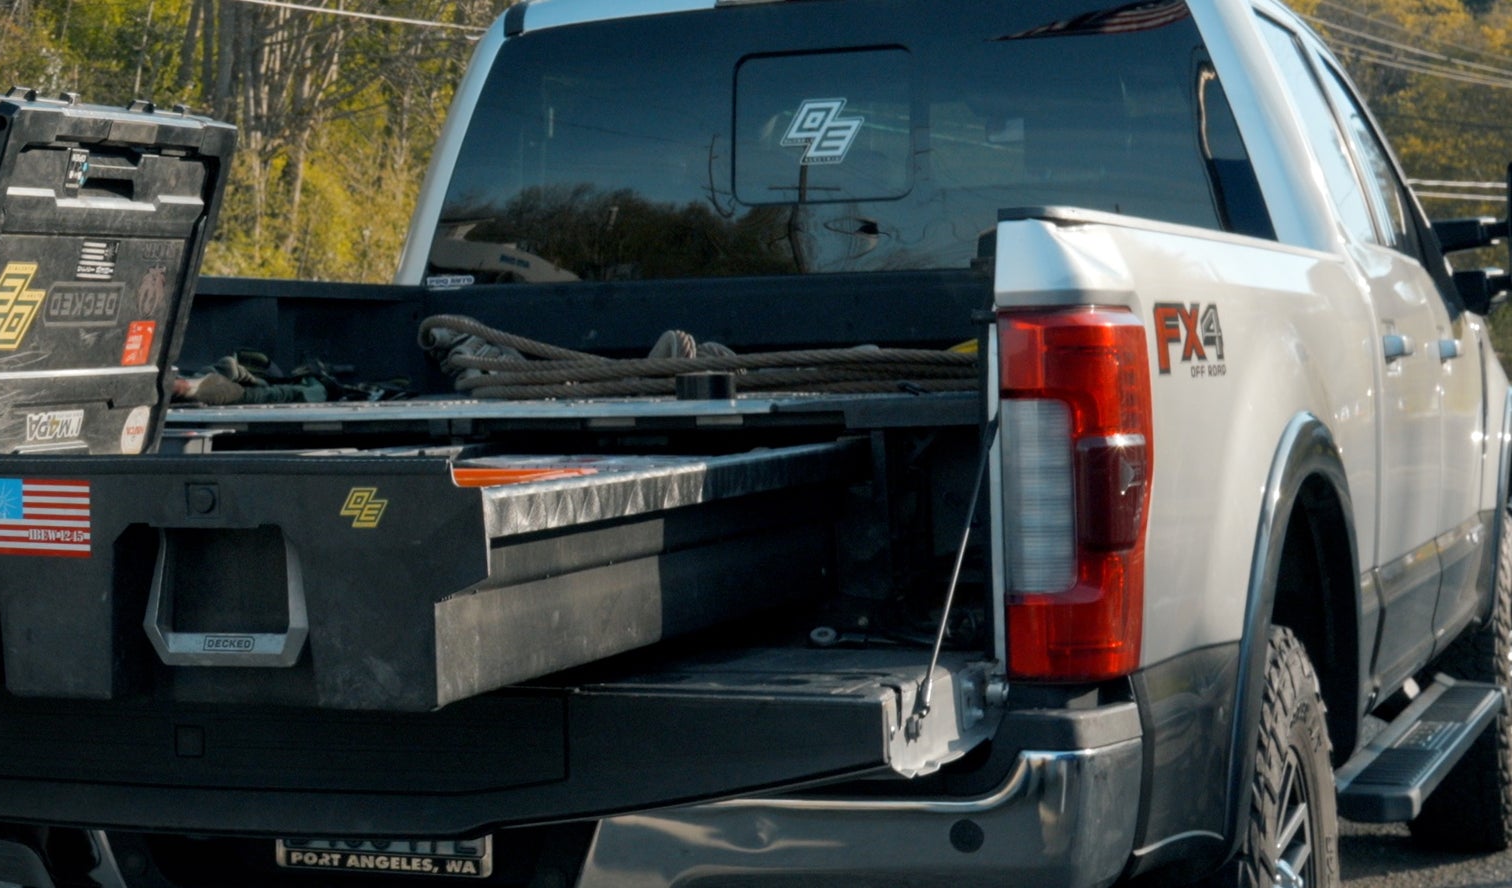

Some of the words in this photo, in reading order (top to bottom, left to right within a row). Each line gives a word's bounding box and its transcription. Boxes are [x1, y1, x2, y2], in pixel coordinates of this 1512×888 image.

[50, 292, 119, 316] DECKED
[1153, 303, 1225, 375] FX4
[1190, 365, 1206, 377] OFF
[1208, 364, 1227, 376] ROAD
[207, 639, 251, 649] DECKED
[290, 851, 342, 866] PORT
[346, 854, 439, 874] ANGELES,
[445, 859, 477, 875] WA
